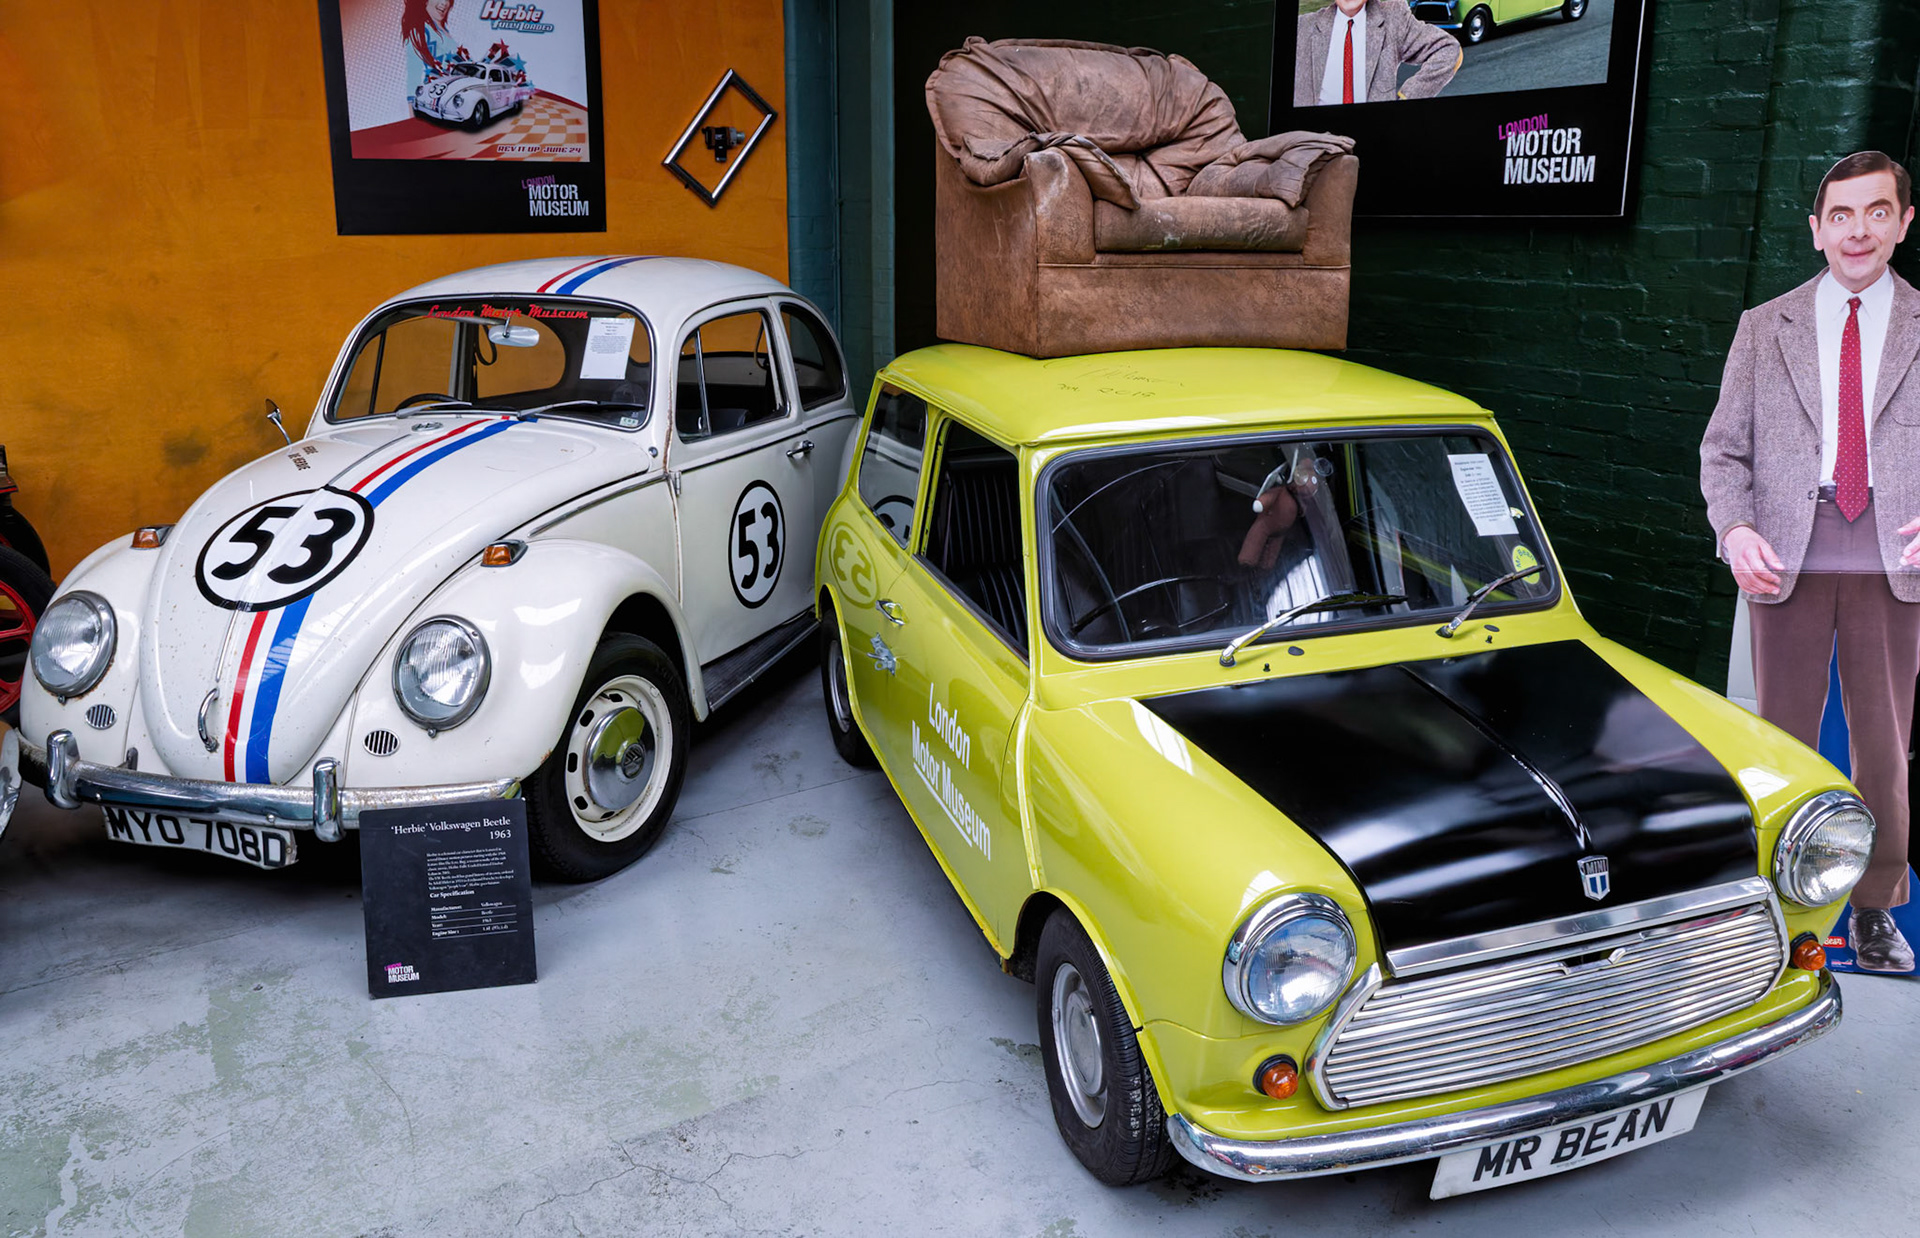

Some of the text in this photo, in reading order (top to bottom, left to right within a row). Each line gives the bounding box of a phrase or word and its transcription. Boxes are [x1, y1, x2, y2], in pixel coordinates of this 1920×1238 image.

[481, 0, 542, 21] Herbie
[430, 83, 446, 95] 53
[1498, 113, 1548, 140] LONDON
[1506, 127, 1582, 157] MOTOR
[1503, 155, 1596, 184] MUSEUM
[521, 174, 555, 190] LONDON
[528, 184, 578, 200] MOTOR
[529, 200, 589, 216] MUSEUM
[425, 304, 588, 319] London Motor Museum
[211, 506, 356, 584] 53
[738, 501, 780, 589] 53
[929, 682, 971, 769] London
[912, 720, 991, 862] Motor Museum
[430, 821, 481, 832] Volkswagen
[483, 816, 511, 827] Beetle
[104, 806, 287, 868] MYO 708D
[490, 829, 512, 840] 1963
[1585, 859, 1606, 875] MINI
[440, 890, 475, 898] Specification
[387, 965, 414, 975] MOTOR
[388, 972, 420, 984] MUSEUM
[1472, 1097, 1675, 1182] MR BEAN
